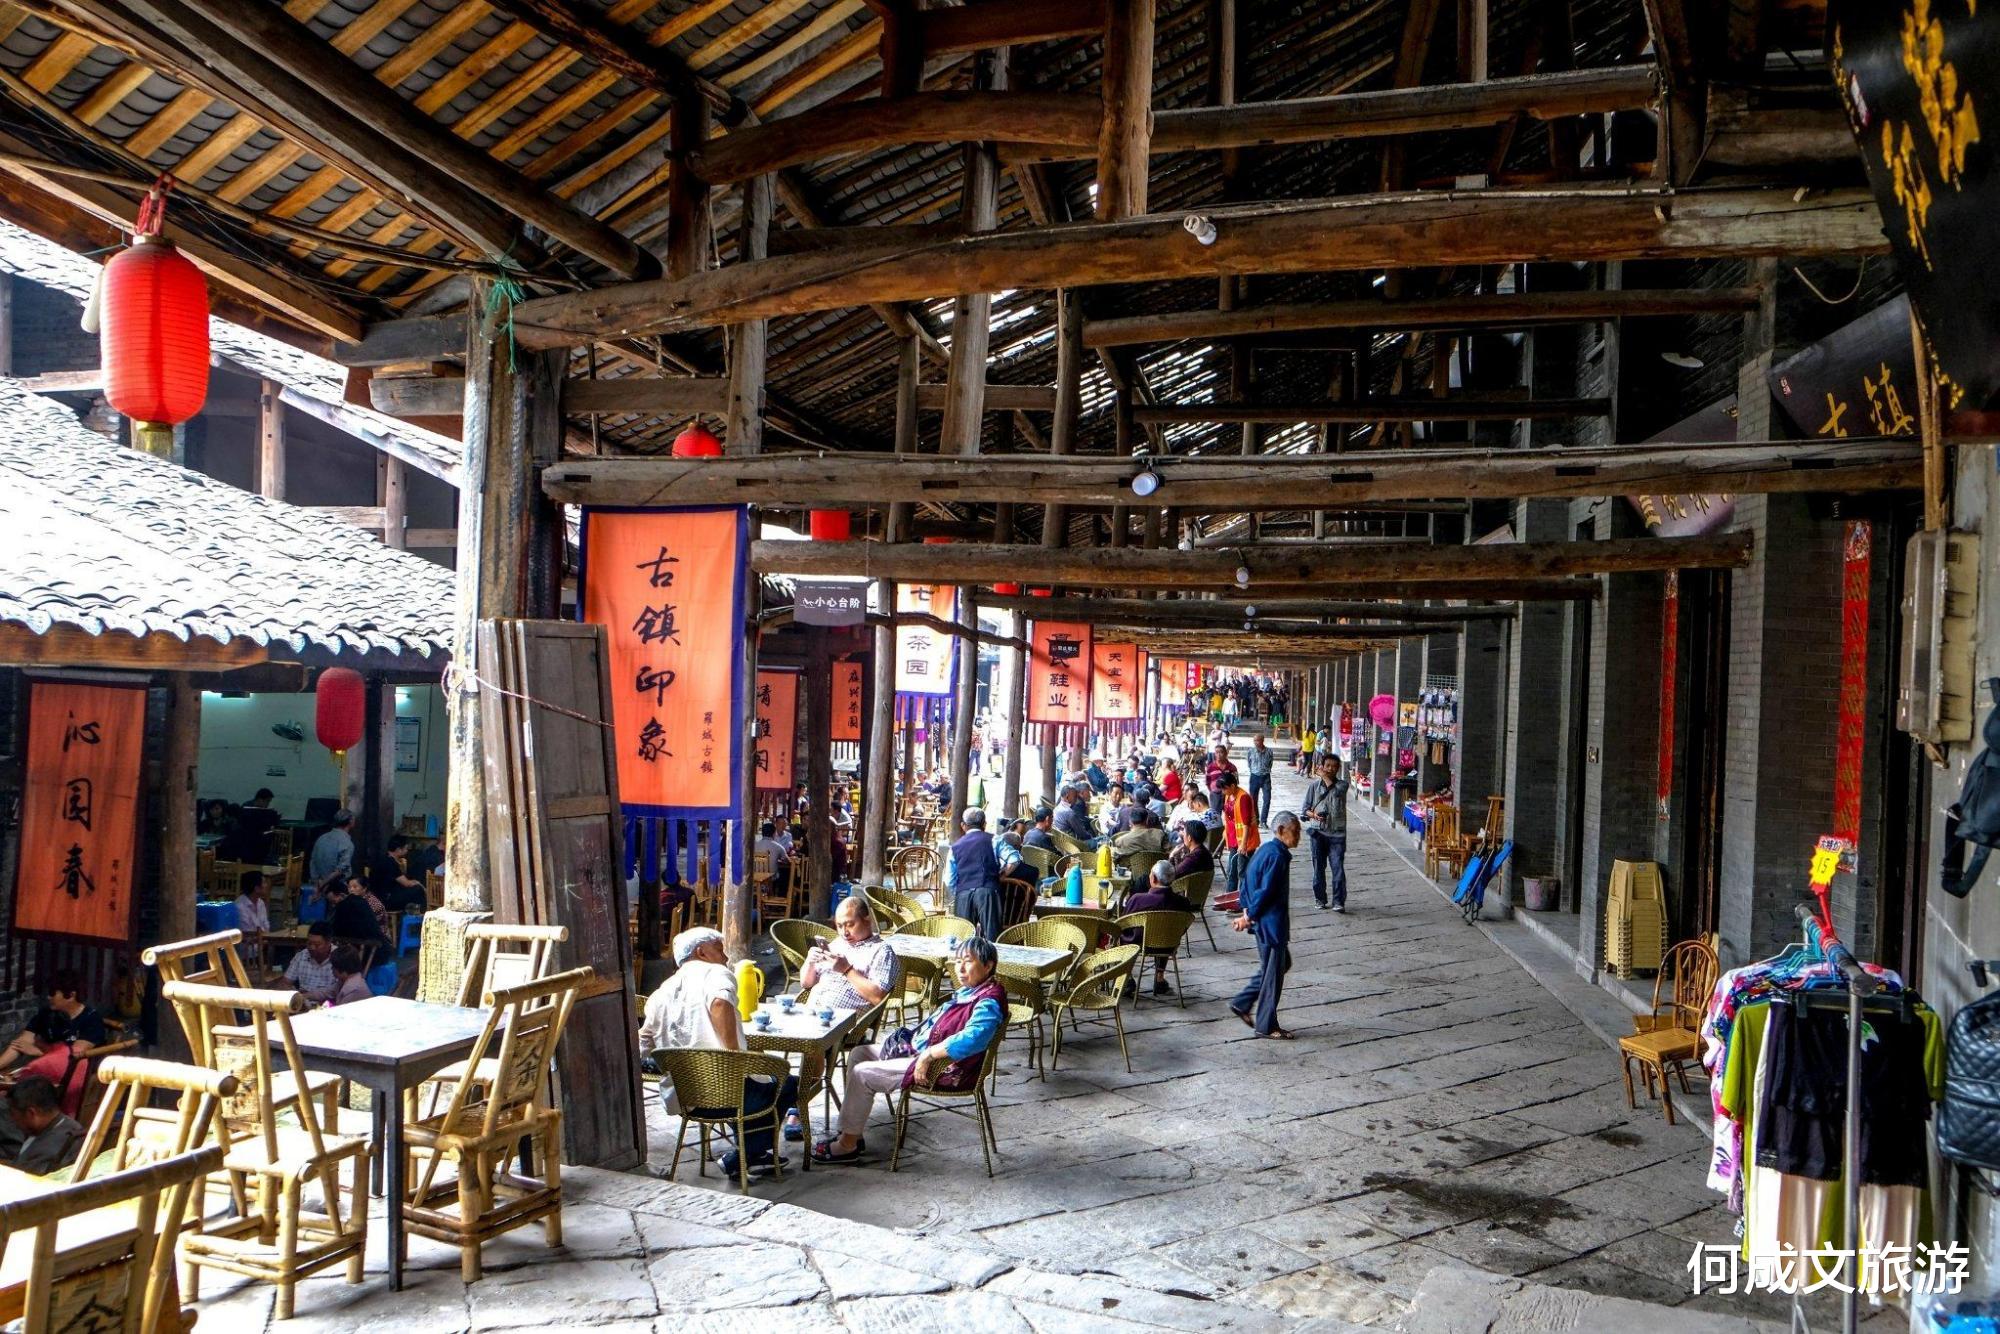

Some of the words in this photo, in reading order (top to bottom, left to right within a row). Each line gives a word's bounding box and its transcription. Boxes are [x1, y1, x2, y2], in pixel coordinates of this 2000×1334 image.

[815, 596, 861, 609] 小心台阶
[906, 586, 935, 675] 七茶园
[632, 545, 681, 762] 古鎮印象
